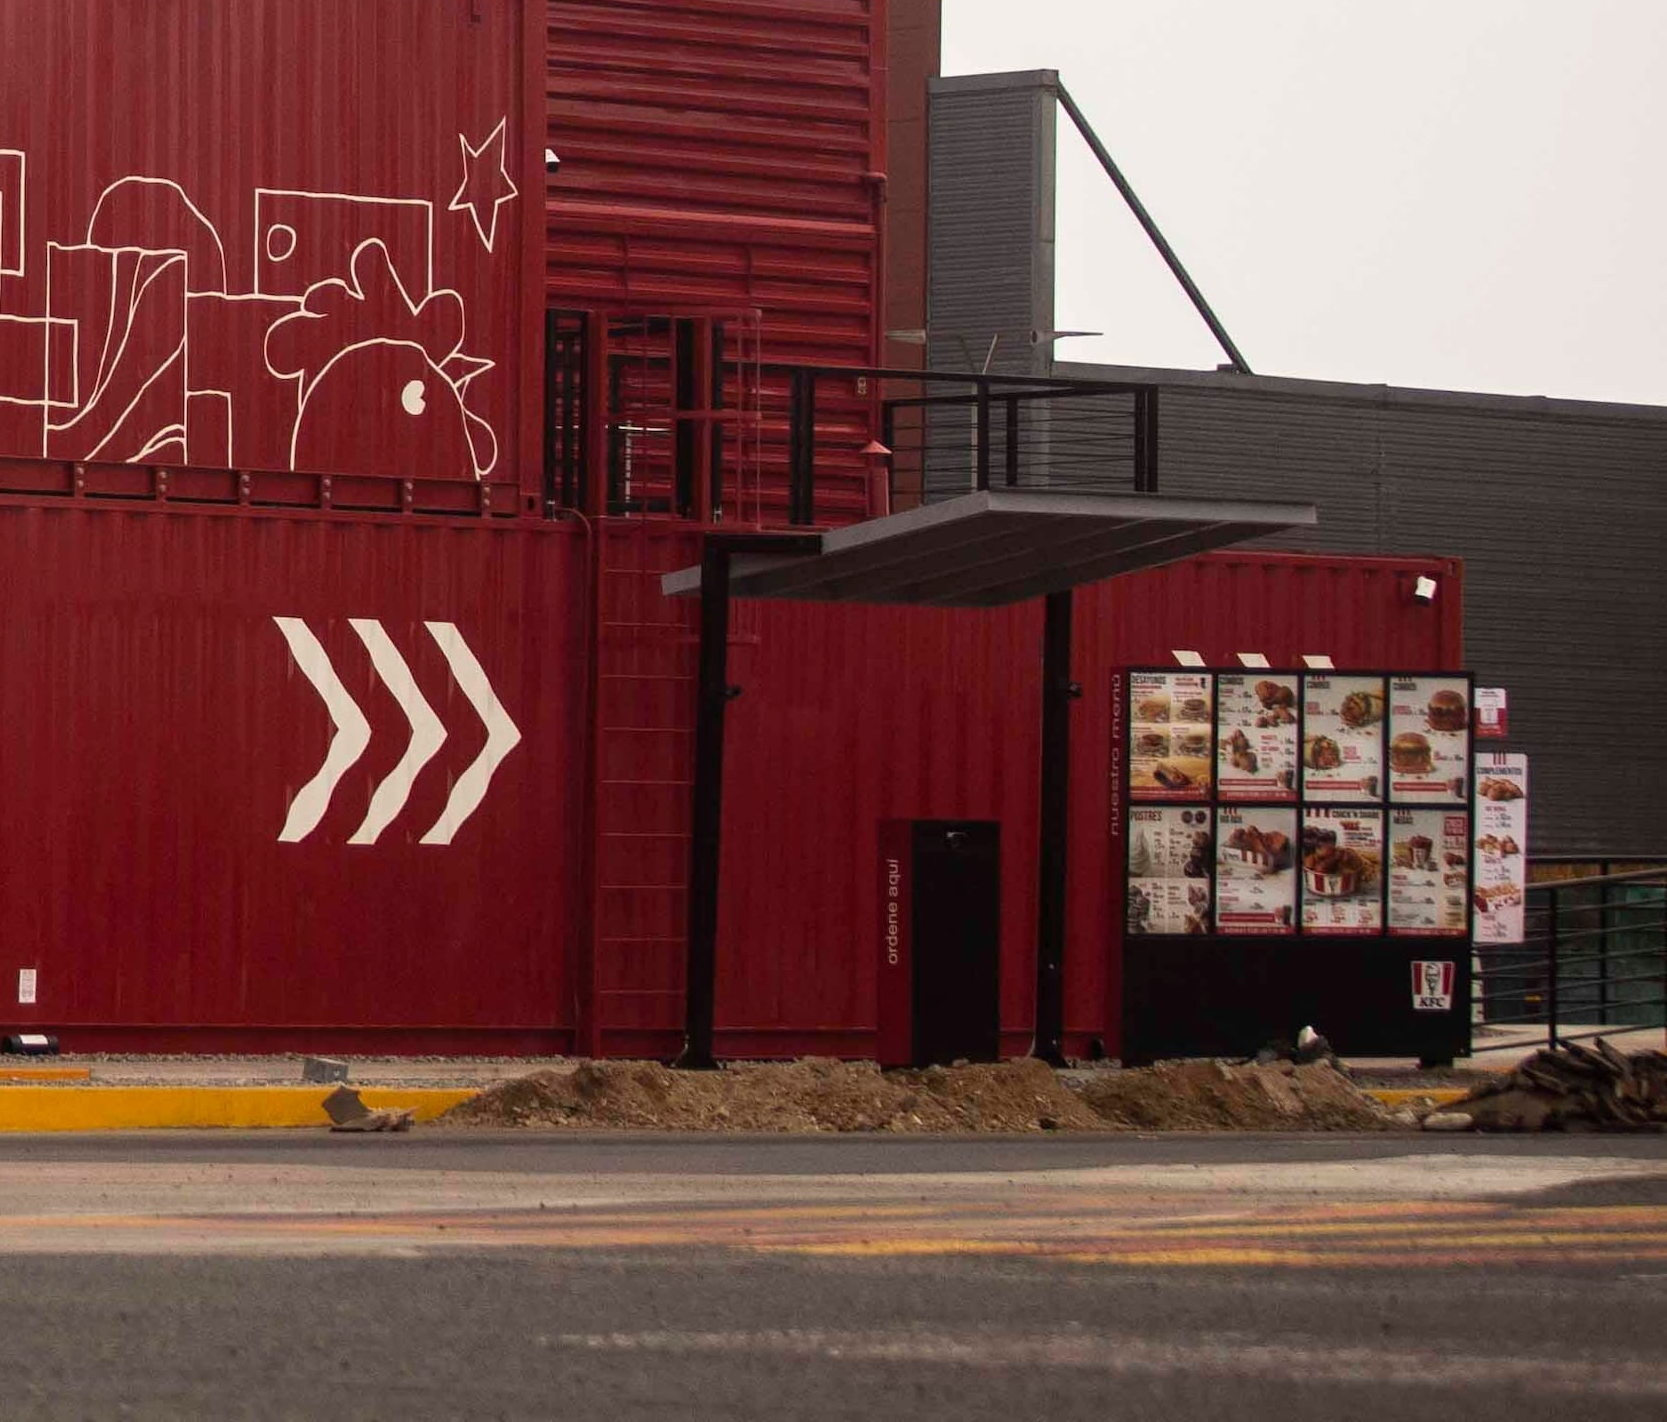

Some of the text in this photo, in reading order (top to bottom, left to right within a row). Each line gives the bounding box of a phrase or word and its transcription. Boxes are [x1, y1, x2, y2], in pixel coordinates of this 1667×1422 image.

[886, 859, 901, 964] ordene aquí
[1419, 996, 1446, 1007] KFC
